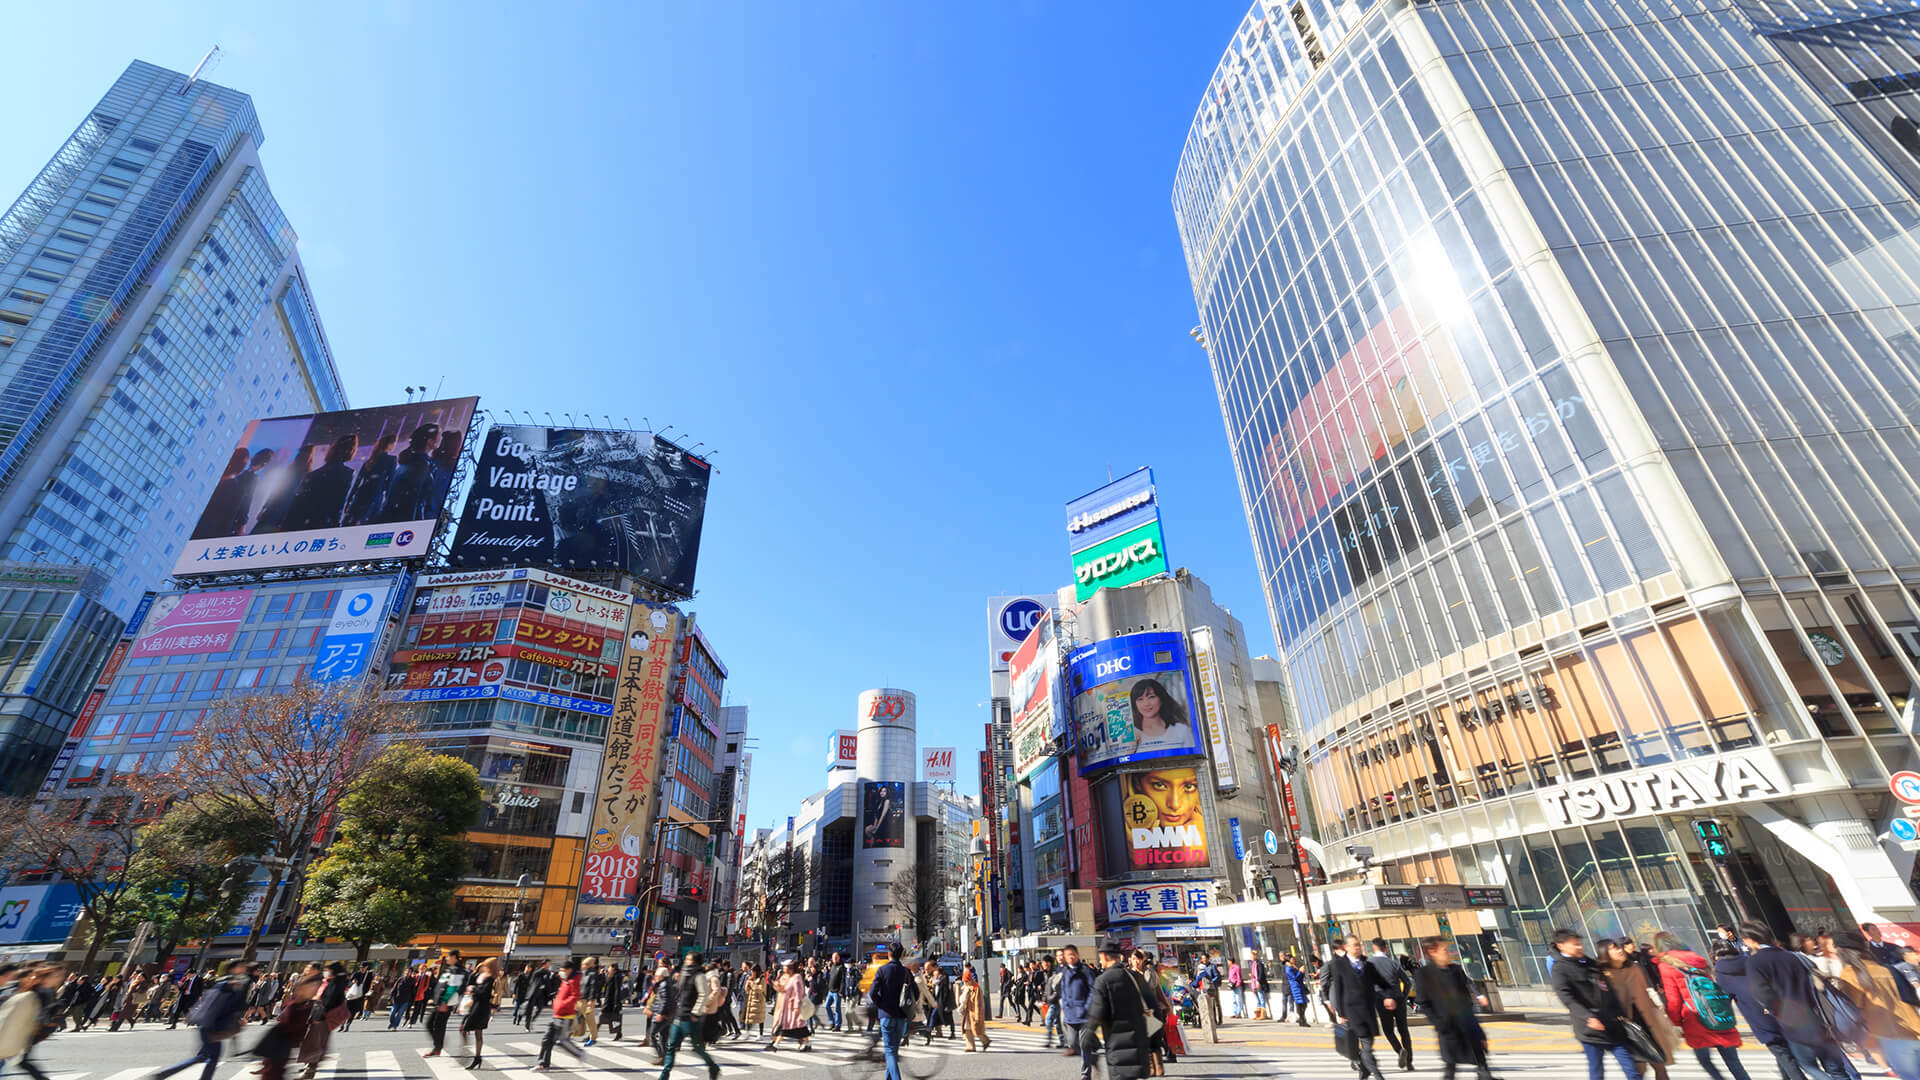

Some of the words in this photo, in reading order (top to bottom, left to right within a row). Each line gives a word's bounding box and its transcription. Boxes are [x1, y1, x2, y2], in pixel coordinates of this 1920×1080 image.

[488, 465, 577, 492] Vantage
[476, 498, 541, 522] Point.
[196, 537, 347, 562] 人生楽しい人の勝ち。
[397, 532, 414, 545] UC
[463, 529, 545, 552] HondaJet
[1075, 538, 1158, 584] サロンパス
[544, 573, 629, 602] しゃぶしゃぶバイキング
[196, 596, 246, 609] 品川スキン
[416, 597, 430, 606] 9F
[576, 599, 625, 623] しゃぶ葉
[192, 607, 236, 620] クリニック
[151, 633, 229, 650] 品川美容外科
[421, 622, 496, 642] プライス
[518, 621, 601, 652] コンタクト
[457, 646, 495, 662] ガスト
[430, 667, 479, 687] ガスト
[570, 657, 610, 678] ガスト
[1096, 655, 1131, 678] DHC
[411, 686, 480, 701] 英会話イーオン
[538, 693, 612, 714] 英会話イーオン
[867, 700, 905, 723] 109
[625, 635, 672, 814] 打首獄門同好会が
[603, 655, 644, 825] 日本武道館だって。
[842, 748, 857, 759] QL
[1545, 757, 1782, 826] TSUTAYA
[1132, 825, 1203, 849] DMM
[585, 856, 639, 880] 2018
[1134, 848, 1204, 865] Bitcoin
[588, 878, 628, 900] 3.11
[1109, 888, 1208, 915] 大盛堂書店
[684, 915, 698, 930] LUSH
